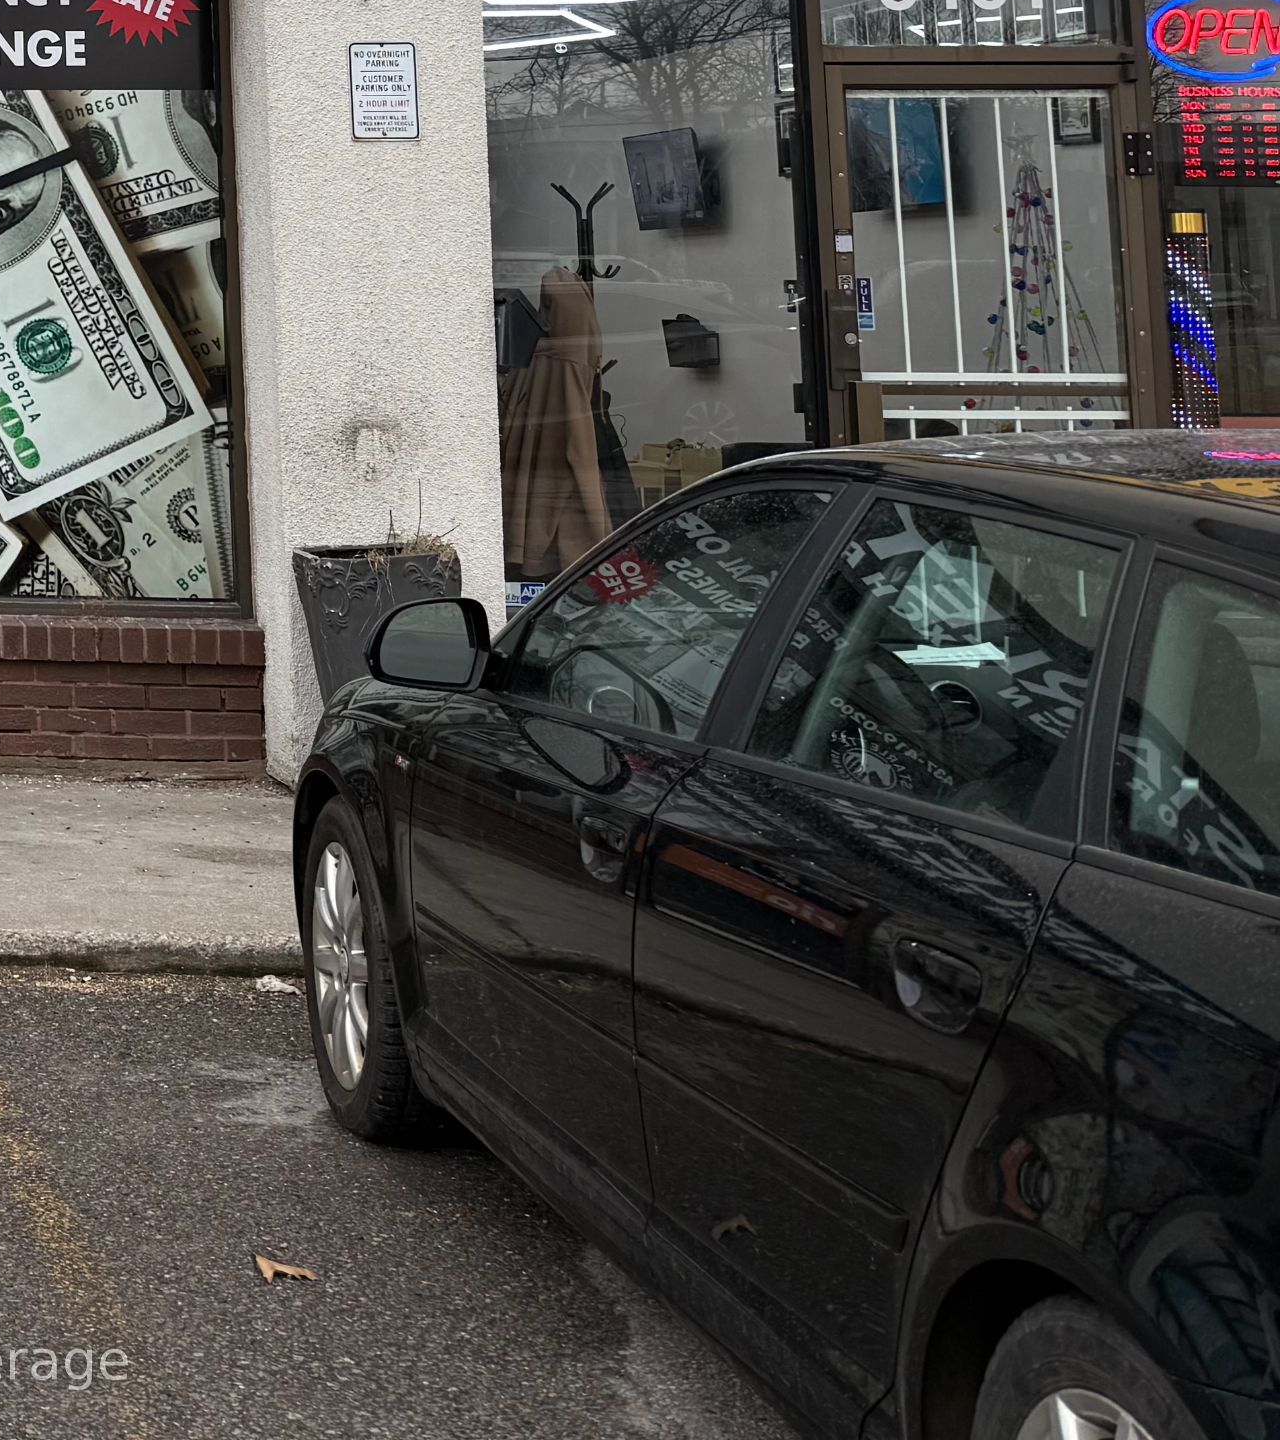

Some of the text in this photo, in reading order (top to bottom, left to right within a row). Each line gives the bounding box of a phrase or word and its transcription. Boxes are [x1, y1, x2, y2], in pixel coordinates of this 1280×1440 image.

[1154, 7, 1280, 55] OPEN
[353, 50, 411, 58] NO OVERNIGHT
[362, 75, 404, 83] CUSTOMER
[355, 84, 412, 92] PARKING ONLY
[1178, 86, 1280, 97] BUSINESS HOURS
[359, 100, 410, 108] 2 HOUR LIMIT
[142, 532, 158, 548] 2
